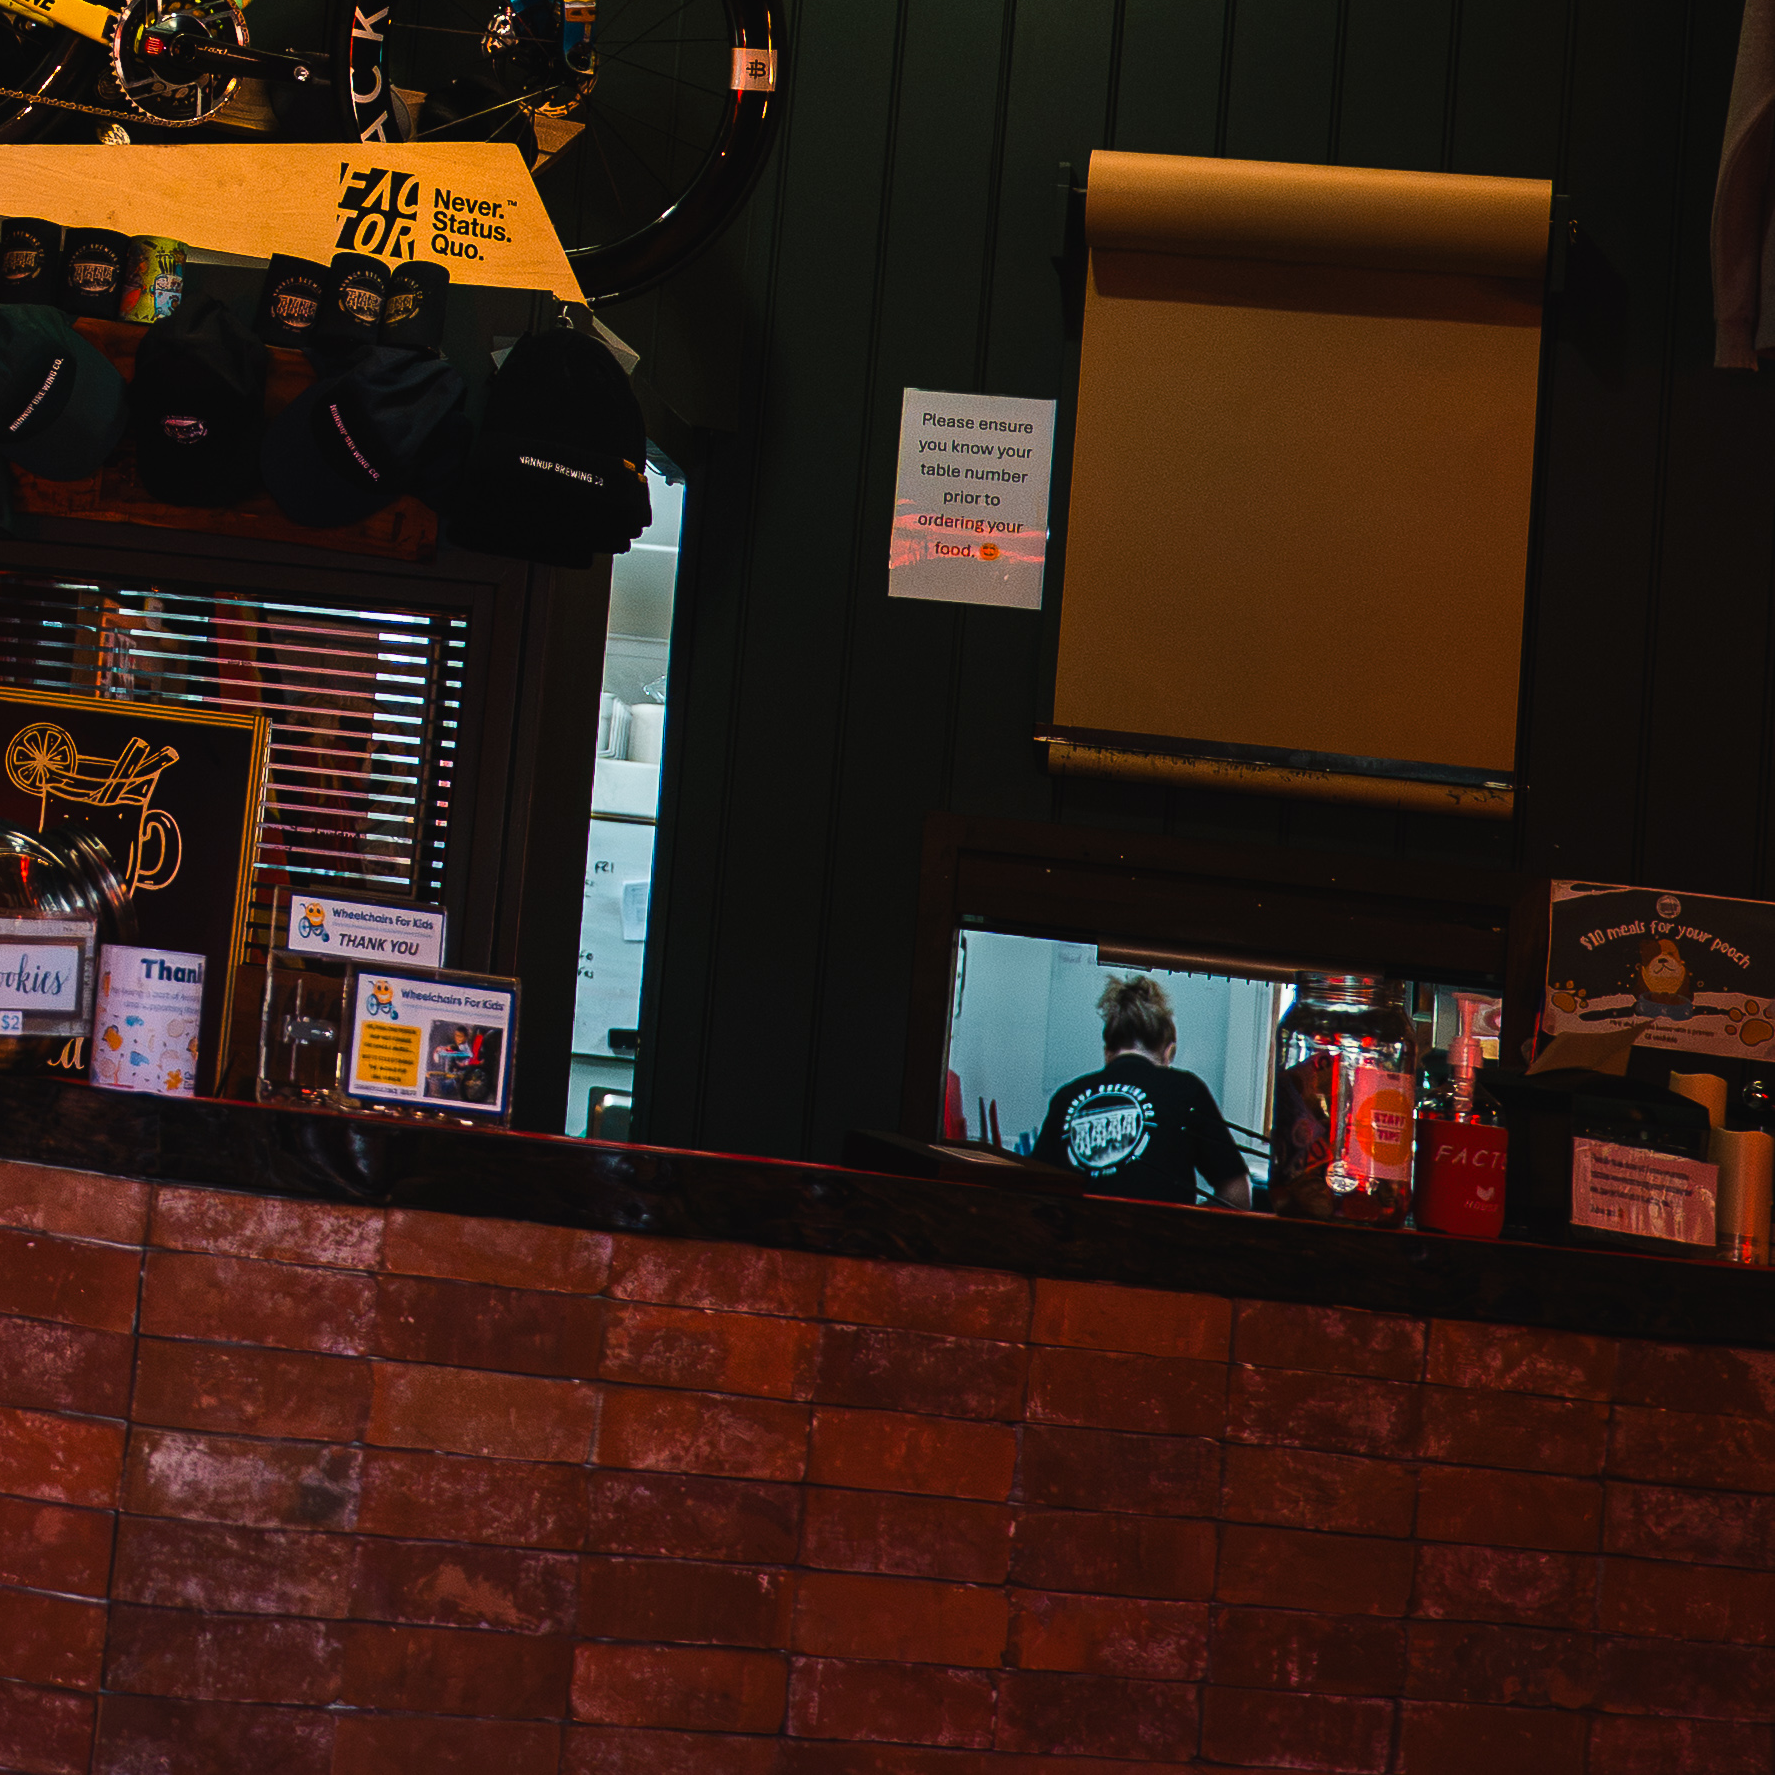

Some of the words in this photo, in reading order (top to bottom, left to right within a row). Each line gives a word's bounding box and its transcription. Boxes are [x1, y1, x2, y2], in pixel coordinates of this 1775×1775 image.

[350, 5, 391, 143] ACK
[432, 211, 512, 243] Status.
[431, 234, 484, 261] Quo.
[922, 412, 975, 430] Please
[978, 419, 1034, 435] ensure
[919, 439, 947, 453] you
[951, 440, 994, 456] know
[997, 446, 1032, 460] your
[920, 463, 961, 478] table
[964, 468, 1028, 484] number
[943, 490, 981, 505] prior
[984, 493, 1000, 507] to
[918, 514, 984, 533] ordering
[987, 520, 1024, 534] your
[935, 541, 975, 558] food.
[332, 907, 394, 925] Wheelchairs
[395, 915, 412, 928] For
[412, 917, 434, 931] Kids
[338, 933, 388, 952] THANK
[389, 940, 420, 956] YOU
[1580, 929, 1606, 951] $10
[1607, 920, 1646, 941] meals
[1650, 920, 1674, 935] for
[1676, 924, 1712, 943] your
[1711, 938, 1751, 969] pooch
[401, 988, 463, 1007] Wheelchairs
[464, 996, 481, 1009] For
[482, 999, 505, 1012] Kids
[0, 1013, 20, 1031] $2
[1378, 1130, 1400, 1143] TIPS
[1464, 1199, 1499, 1213] HOUSE
